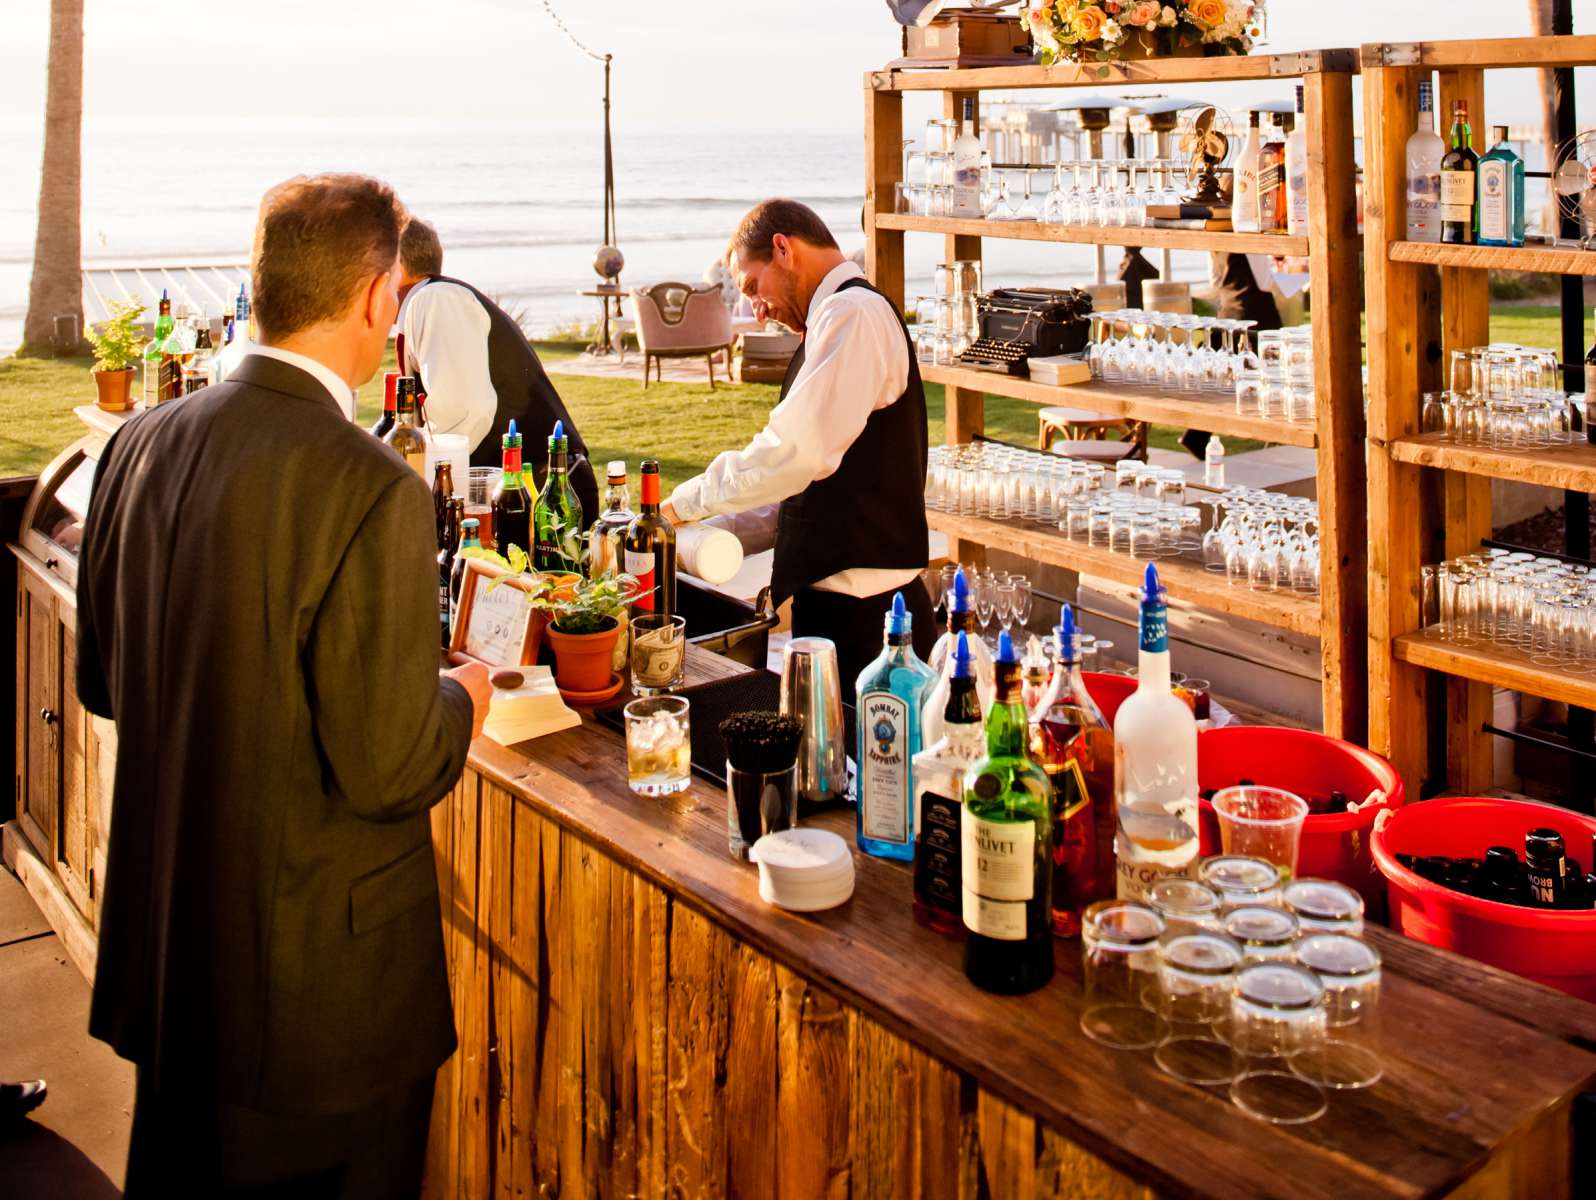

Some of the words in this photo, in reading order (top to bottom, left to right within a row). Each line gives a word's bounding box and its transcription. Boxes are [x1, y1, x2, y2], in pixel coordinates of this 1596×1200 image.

[536, 544, 559, 553] MARTIN
[870, 703, 900, 720] BOMBAY
[868, 747, 902, 766] SAPPHIRE
[975, 836, 1016, 854] NLIVET
[977, 856, 989, 873] 12
[1527, 873, 1553, 888] BROW
[1530, 884, 1554, 903] NU
